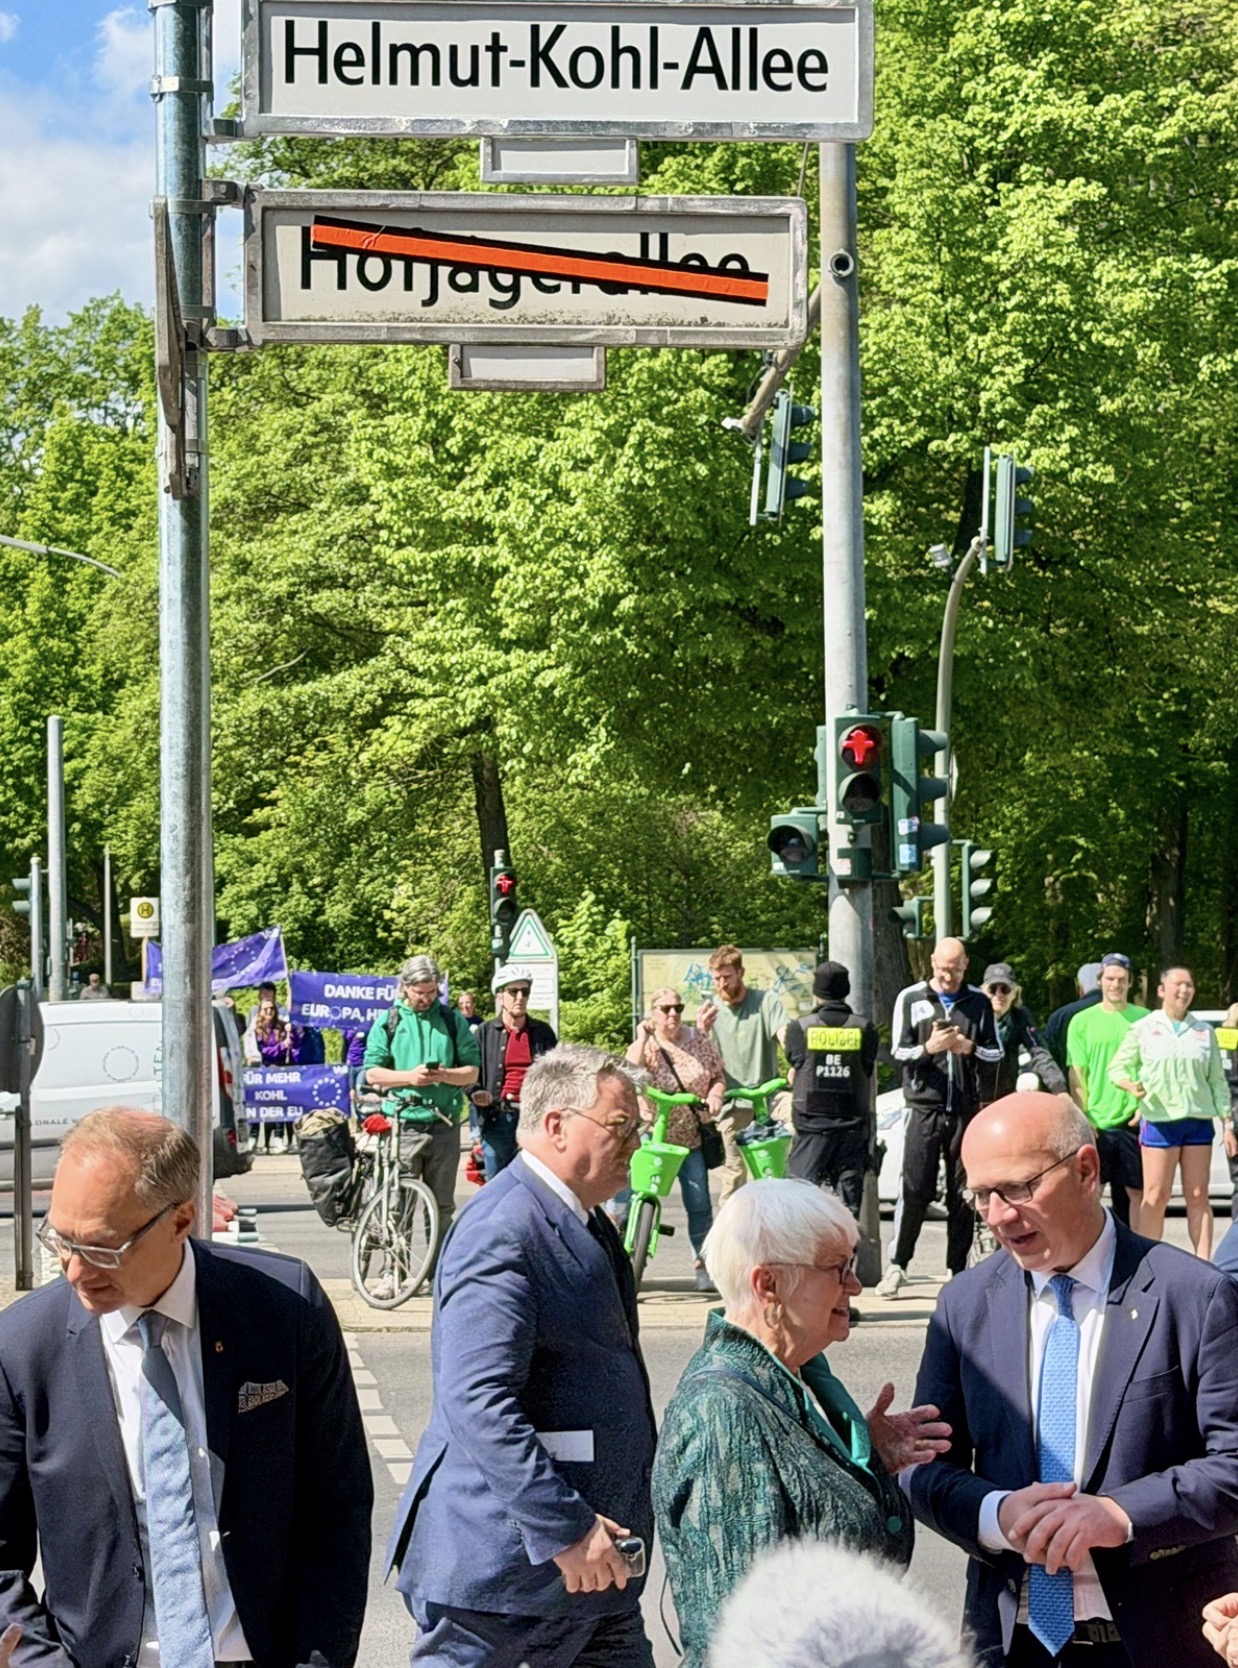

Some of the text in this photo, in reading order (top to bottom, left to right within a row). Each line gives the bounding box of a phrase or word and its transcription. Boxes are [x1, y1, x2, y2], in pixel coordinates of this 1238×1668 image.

[284, 19, 829, 93] Helmut-Kohl-Allee
[324, 984, 396, 1001] DANKE FÜ
[826, 1054, 842, 1065] BE
[266, 1071, 302, 1084] MEHR
[816, 1065, 850, 1078] P1126
[254, 1090, 288, 1101] KOHL
[259, 1106, 285, 1118] DER
[287, 1106, 304, 1117] EU
